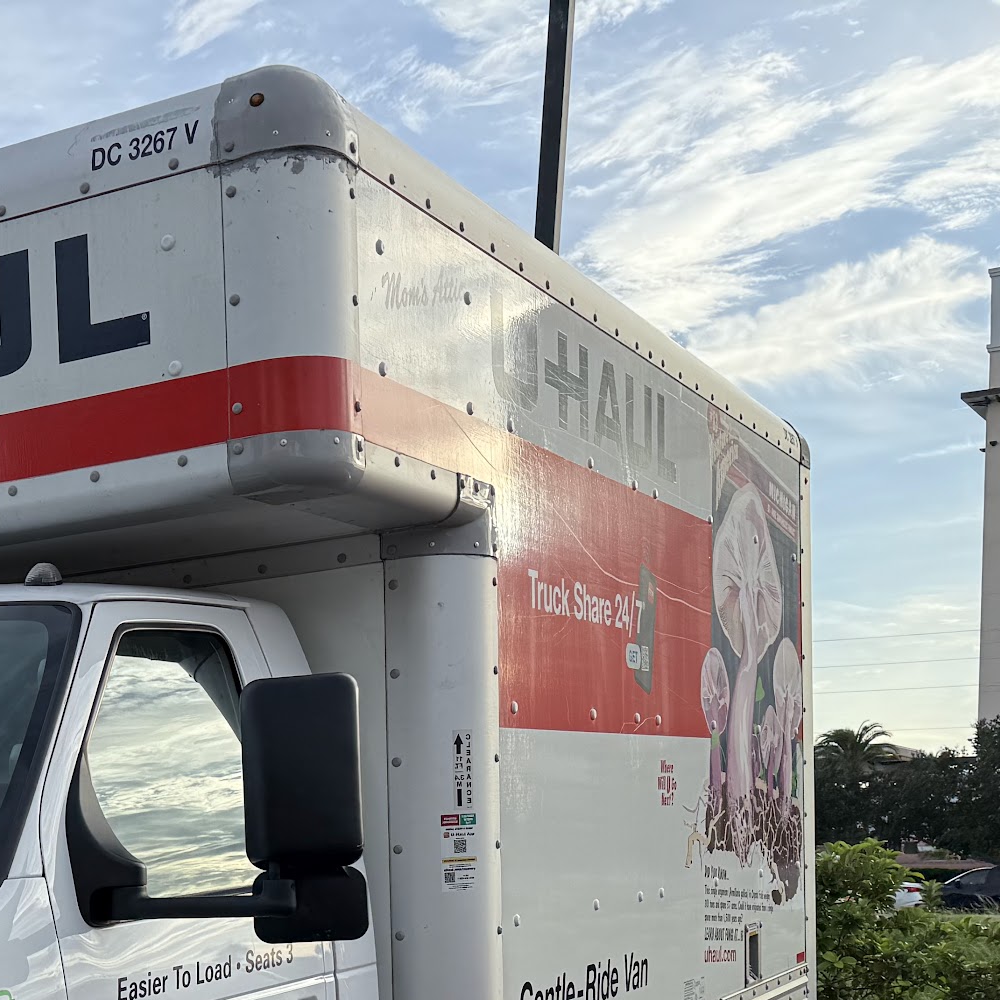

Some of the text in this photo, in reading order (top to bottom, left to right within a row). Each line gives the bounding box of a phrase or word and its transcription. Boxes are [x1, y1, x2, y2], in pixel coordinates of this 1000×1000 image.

[92, 119, 199, 171] DC 3267 V
[527, 568, 571, 617] Truck
[573, 581, 612, 627] Share
[173, 964, 191, 990] To
[196, 954, 232, 985] Load
[245, 947, 283, 974] Seats
[286, 943, 293, 964] 3
[624, 952, 648, 992] Van
[704, 945, 737, 963] uhaul.com
